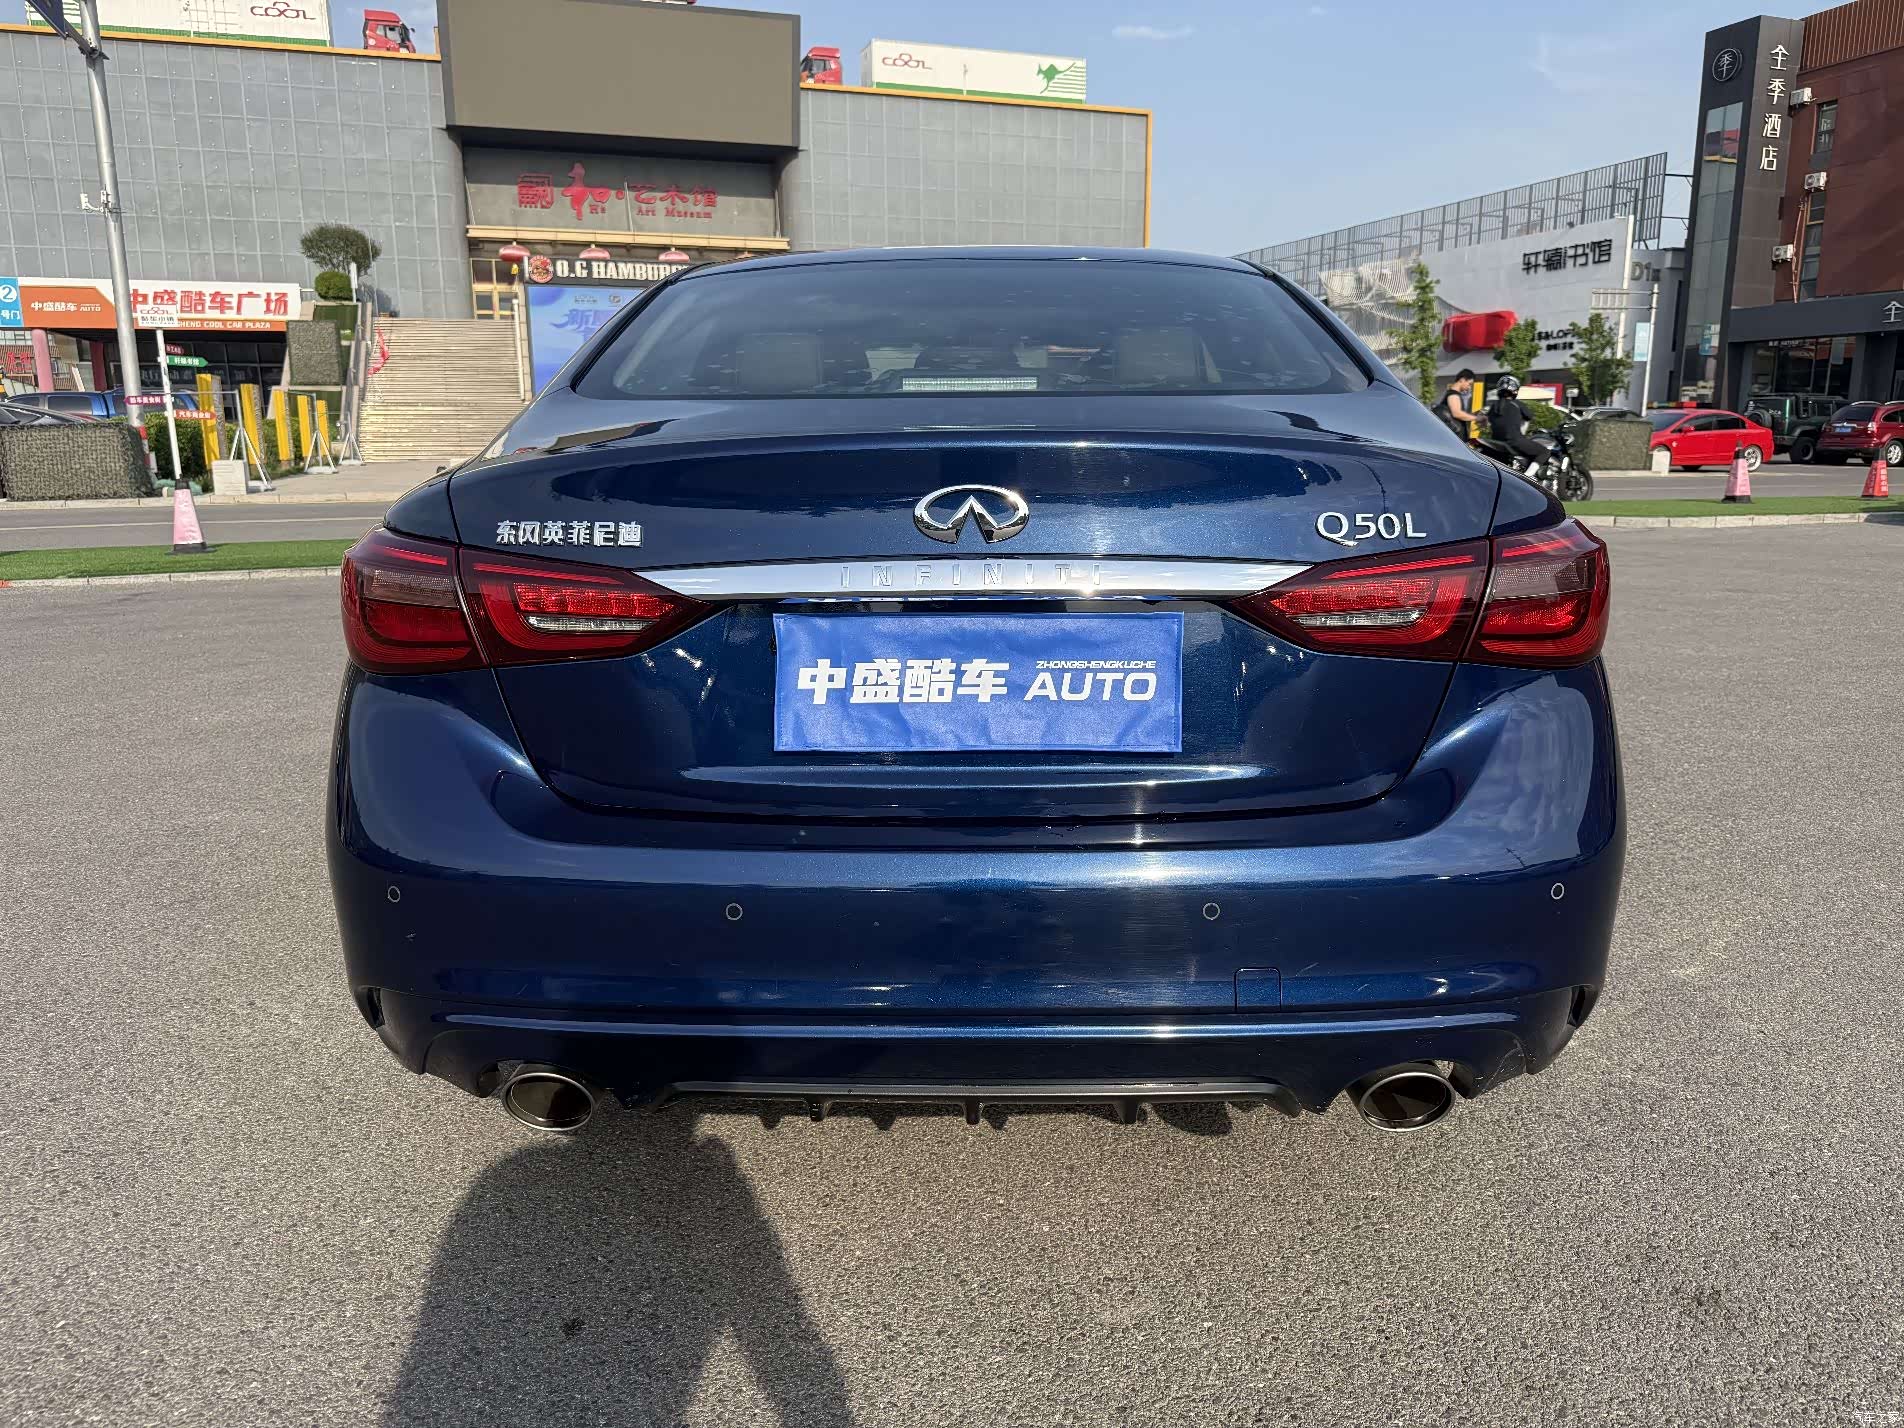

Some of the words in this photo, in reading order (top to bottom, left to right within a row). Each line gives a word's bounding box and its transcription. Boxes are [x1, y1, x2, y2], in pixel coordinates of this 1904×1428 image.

[1719, 52, 1733, 79] 季
[1760, 44, 1790, 171] 全季酒店
[636, 206, 656, 216] Art
[556, 259, 588, 279] O.G
[2, 286, 13, 300] 2
[1, 309, 20, 320] 号门
[31, 301, 77, 312] 中盛酷车
[496, 519, 645, 548] 东风英菲尼迪
[1315, 511, 1428, 547] Q50L
[840, 563, 1101, 588] INFINITI
[1036, 660, 1157, 669] ZHONGSHENGKUCHE
[797, 658, 1010, 705] 中盛酷车
[1023, 672, 1158, 701] AUTO
